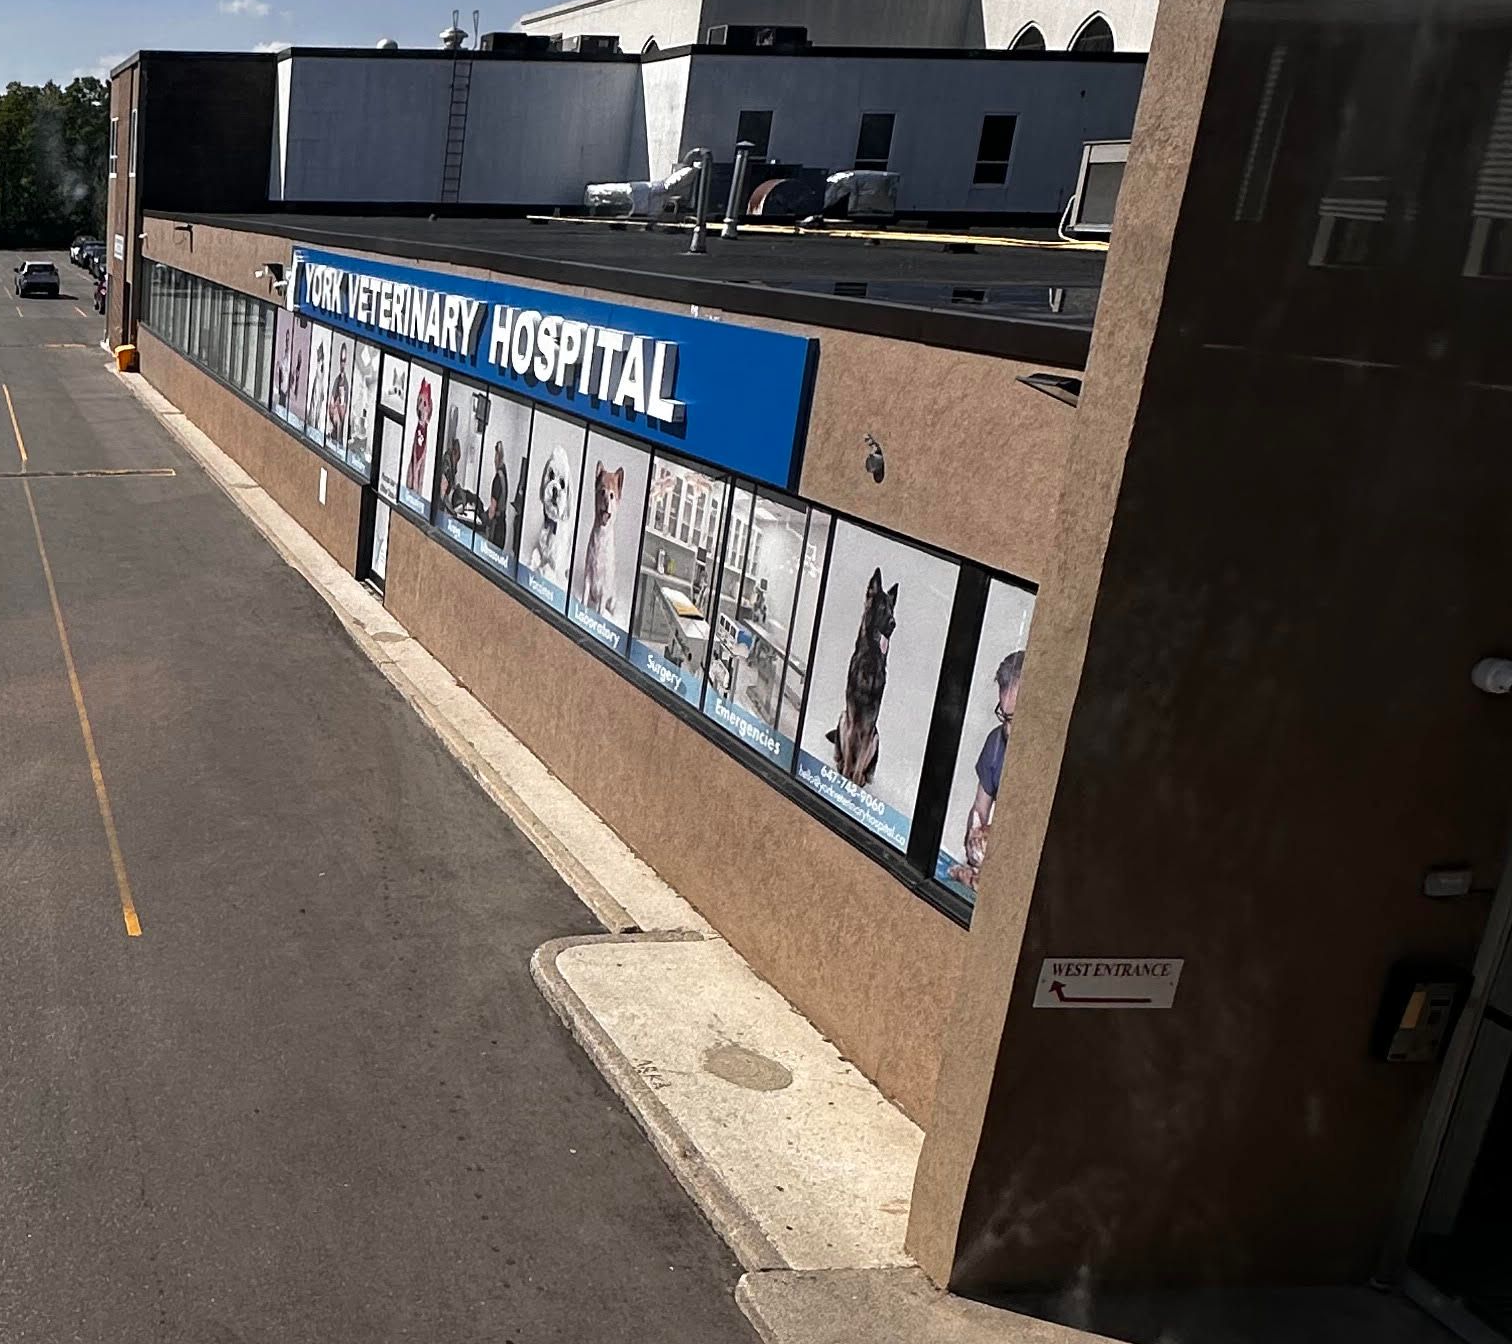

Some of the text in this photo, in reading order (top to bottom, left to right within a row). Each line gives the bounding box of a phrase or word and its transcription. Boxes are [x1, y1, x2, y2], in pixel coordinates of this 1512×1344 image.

[303, 263, 682, 423] YORK VETERINARY HOSPITAL
[574, 603, 621, 649] Laboratory
[646, 654, 683, 690] Surgery
[714, 698, 781, 755] Emergencies
[1052, 962, 1172, 977] WEST ENTRANCE
